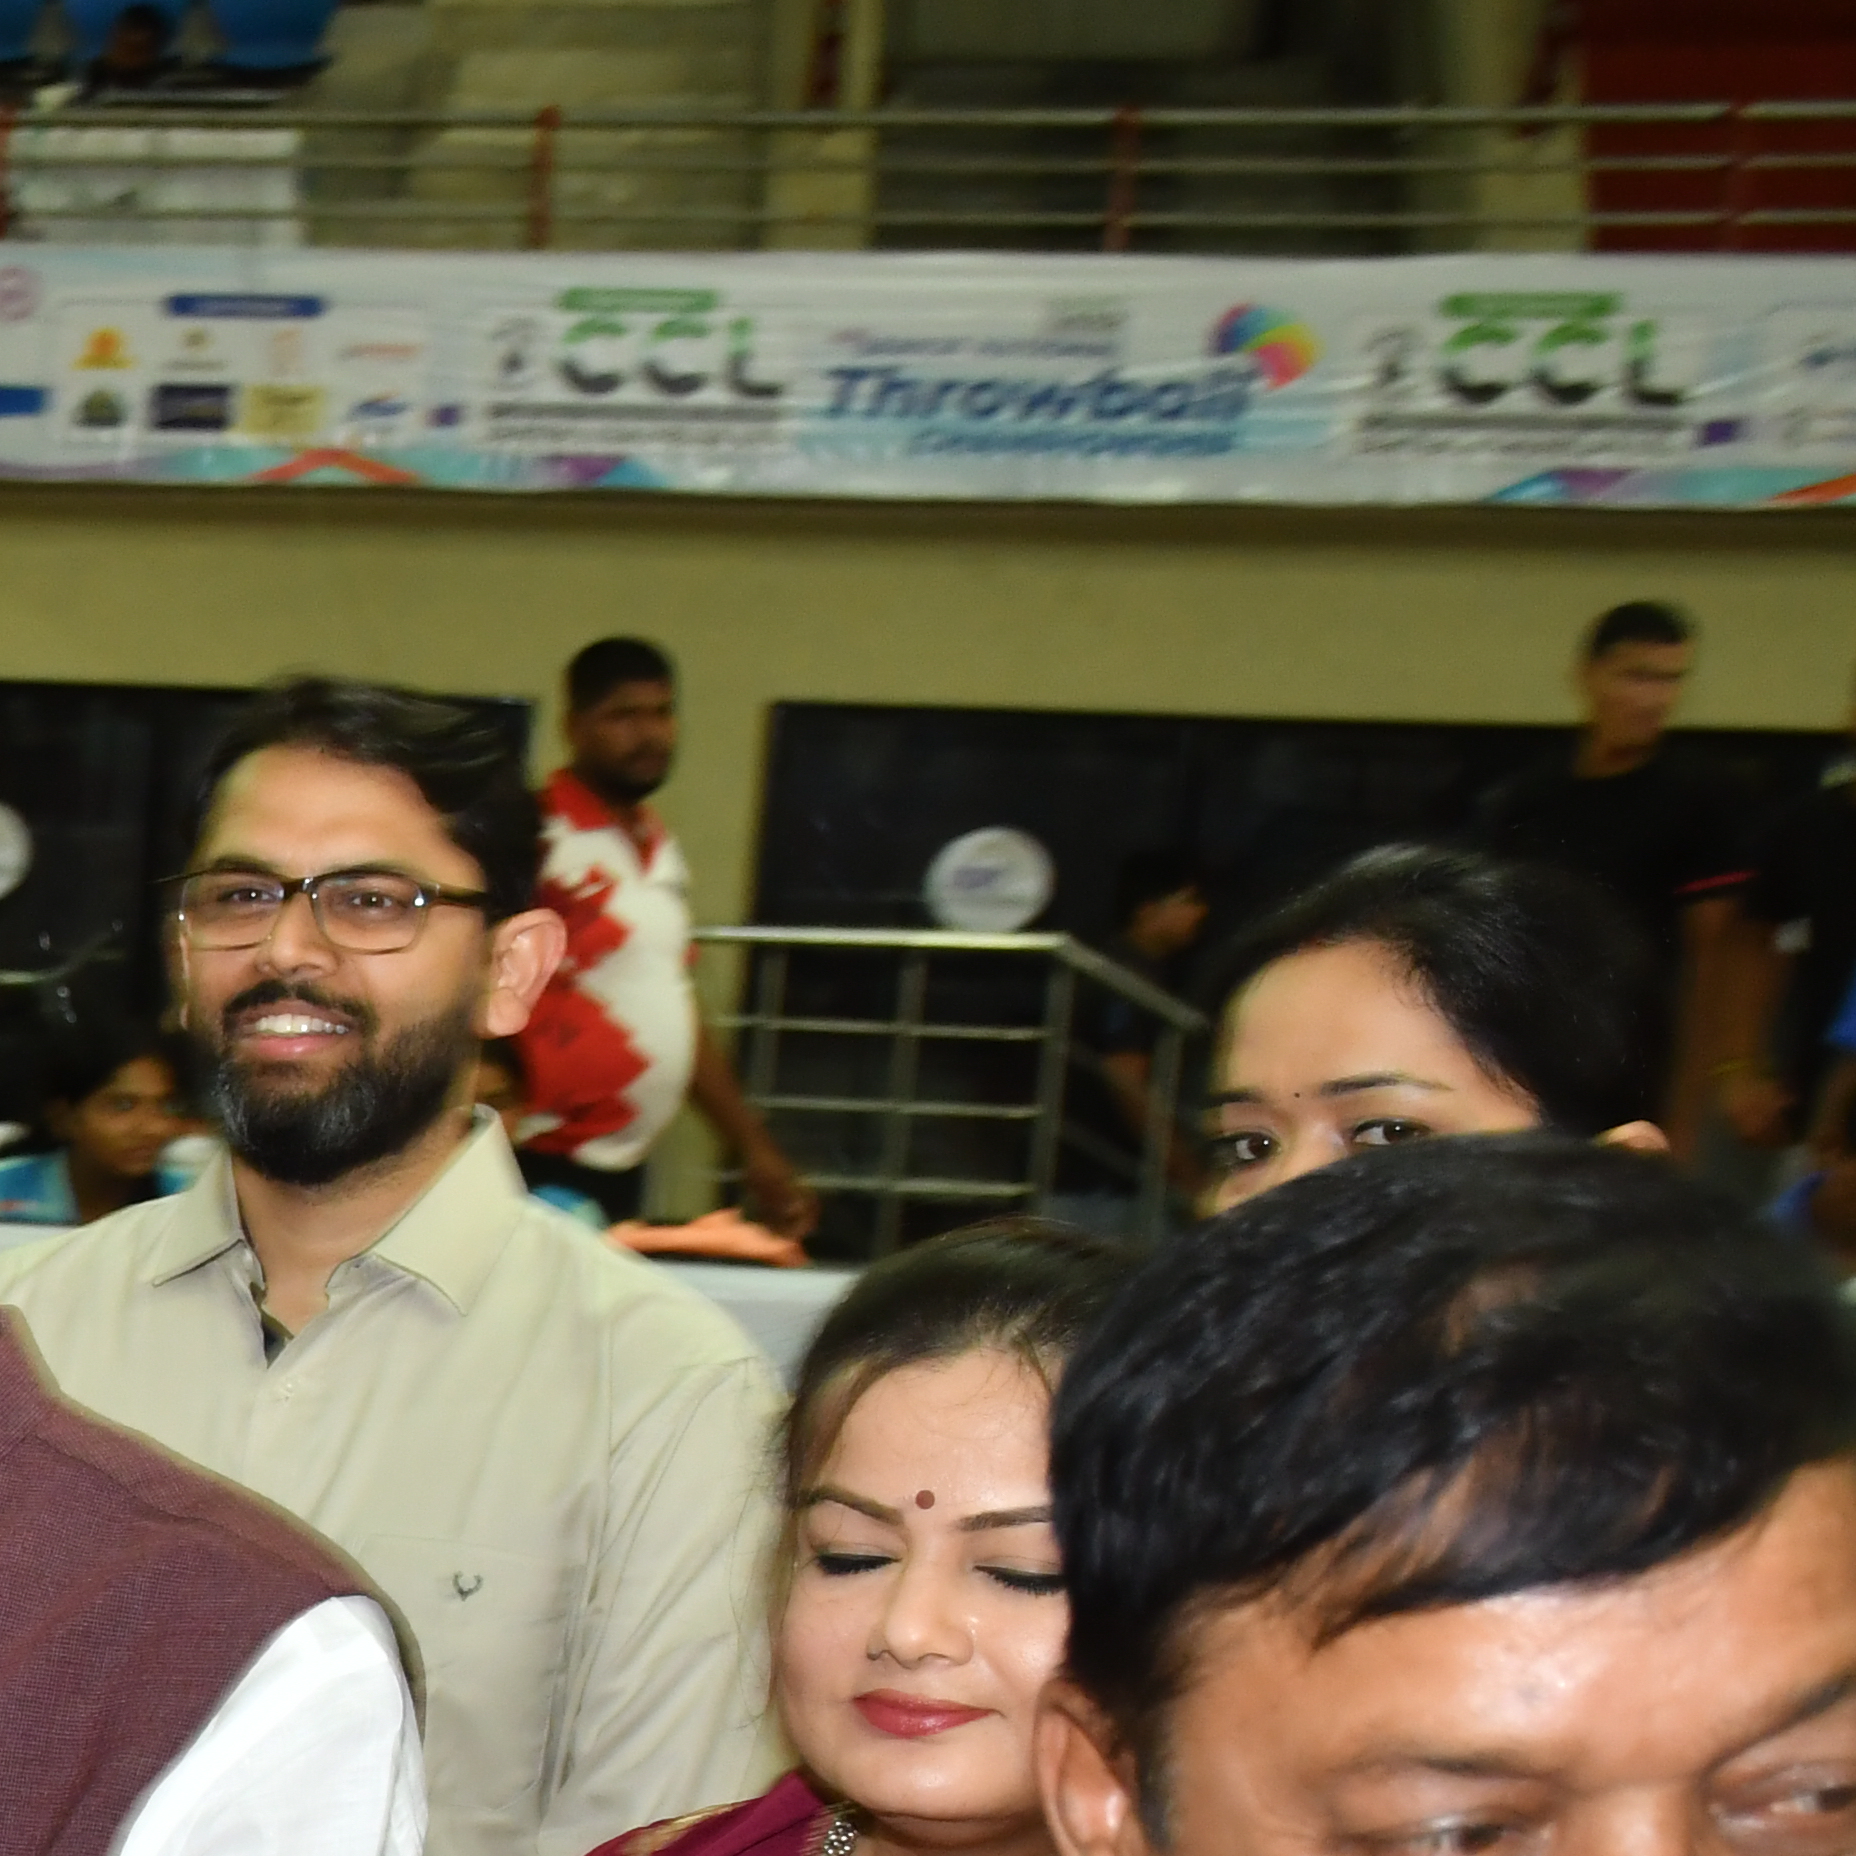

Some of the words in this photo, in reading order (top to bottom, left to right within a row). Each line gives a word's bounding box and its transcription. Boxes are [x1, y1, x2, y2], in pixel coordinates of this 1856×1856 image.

[558, 315, 785, 398] CCL
[826, 366, 1263, 421] Throwball
[1441, 322, 1689, 405] CCL
